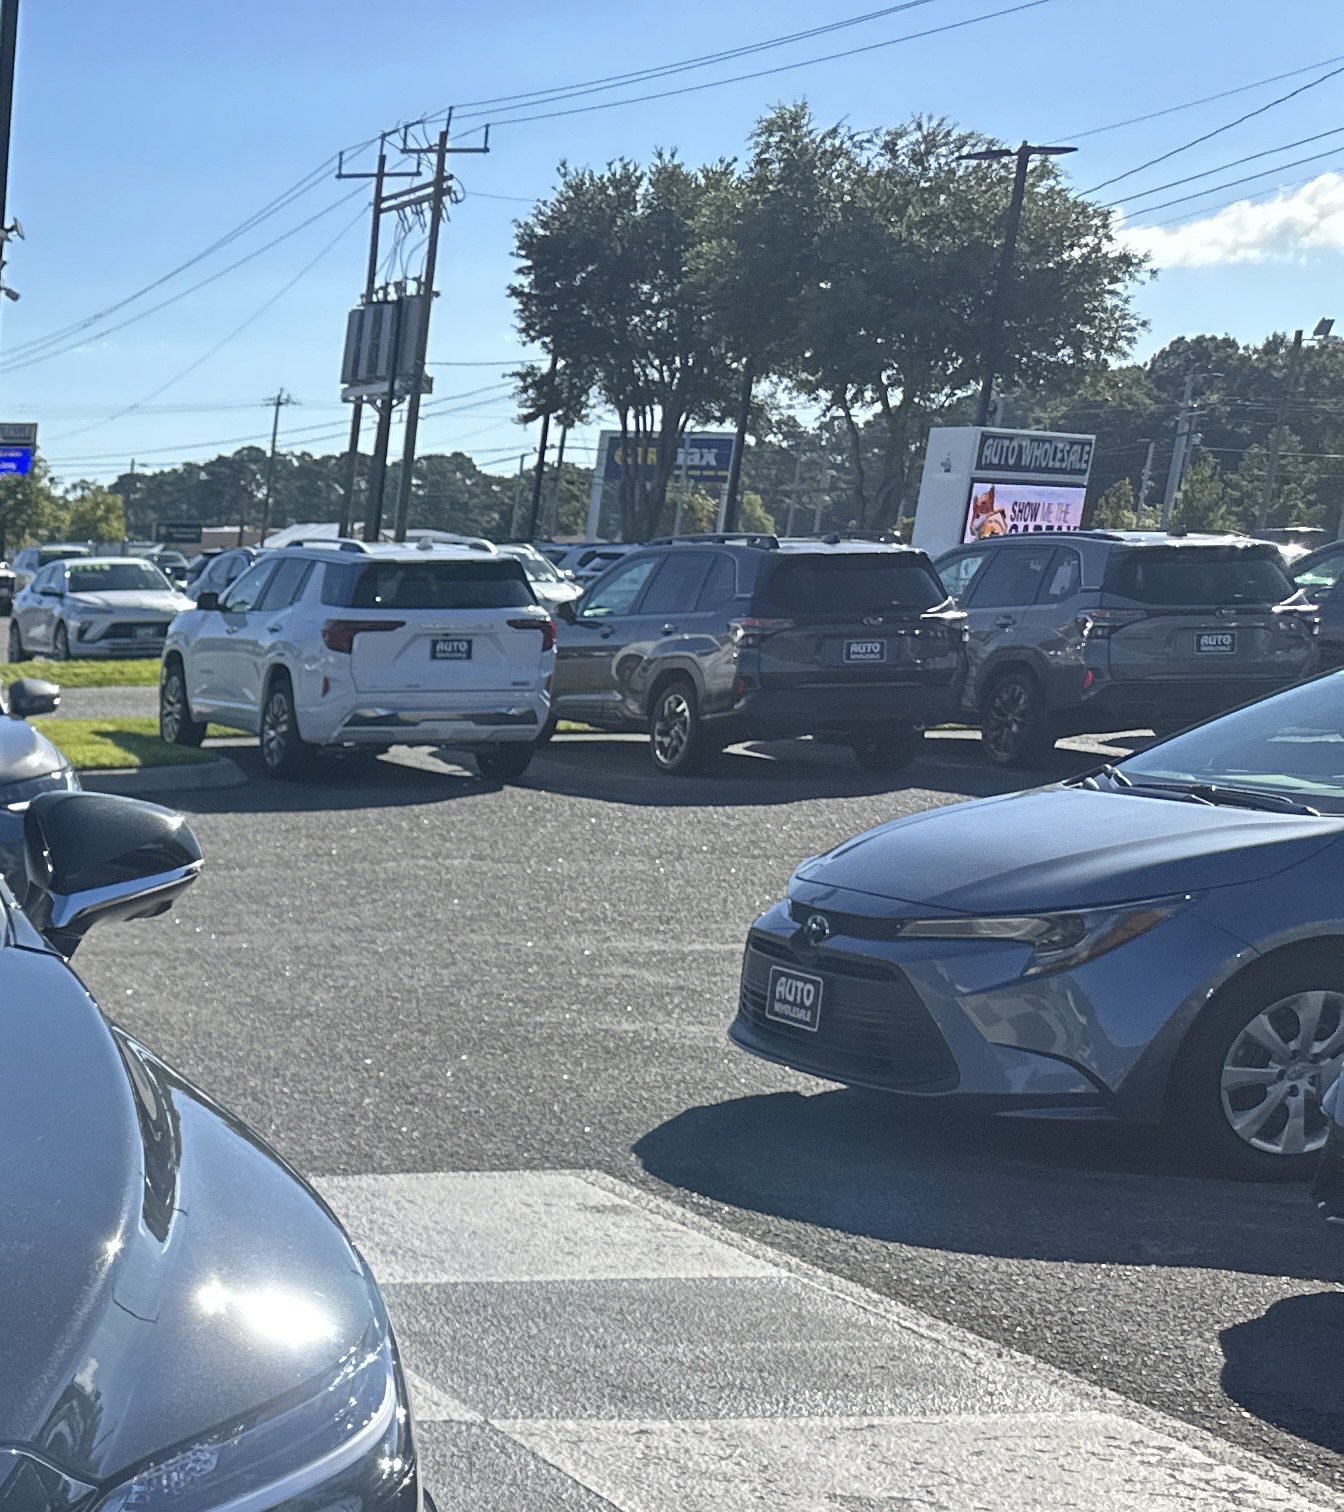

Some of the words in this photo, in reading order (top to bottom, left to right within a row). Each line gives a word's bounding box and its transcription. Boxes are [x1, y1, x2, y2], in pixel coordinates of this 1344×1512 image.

[982, 438, 1018, 466] AUTO
[1020, 439, 1091, 471] WHOLESALE
[1010, 501, 1040, 523] SHOW
[435, 641, 469, 652] AUTO
[850, 643, 881, 653] AUTO
[1200, 634, 1232, 646] AUTO
[775, 976, 815, 1007] AUTO
